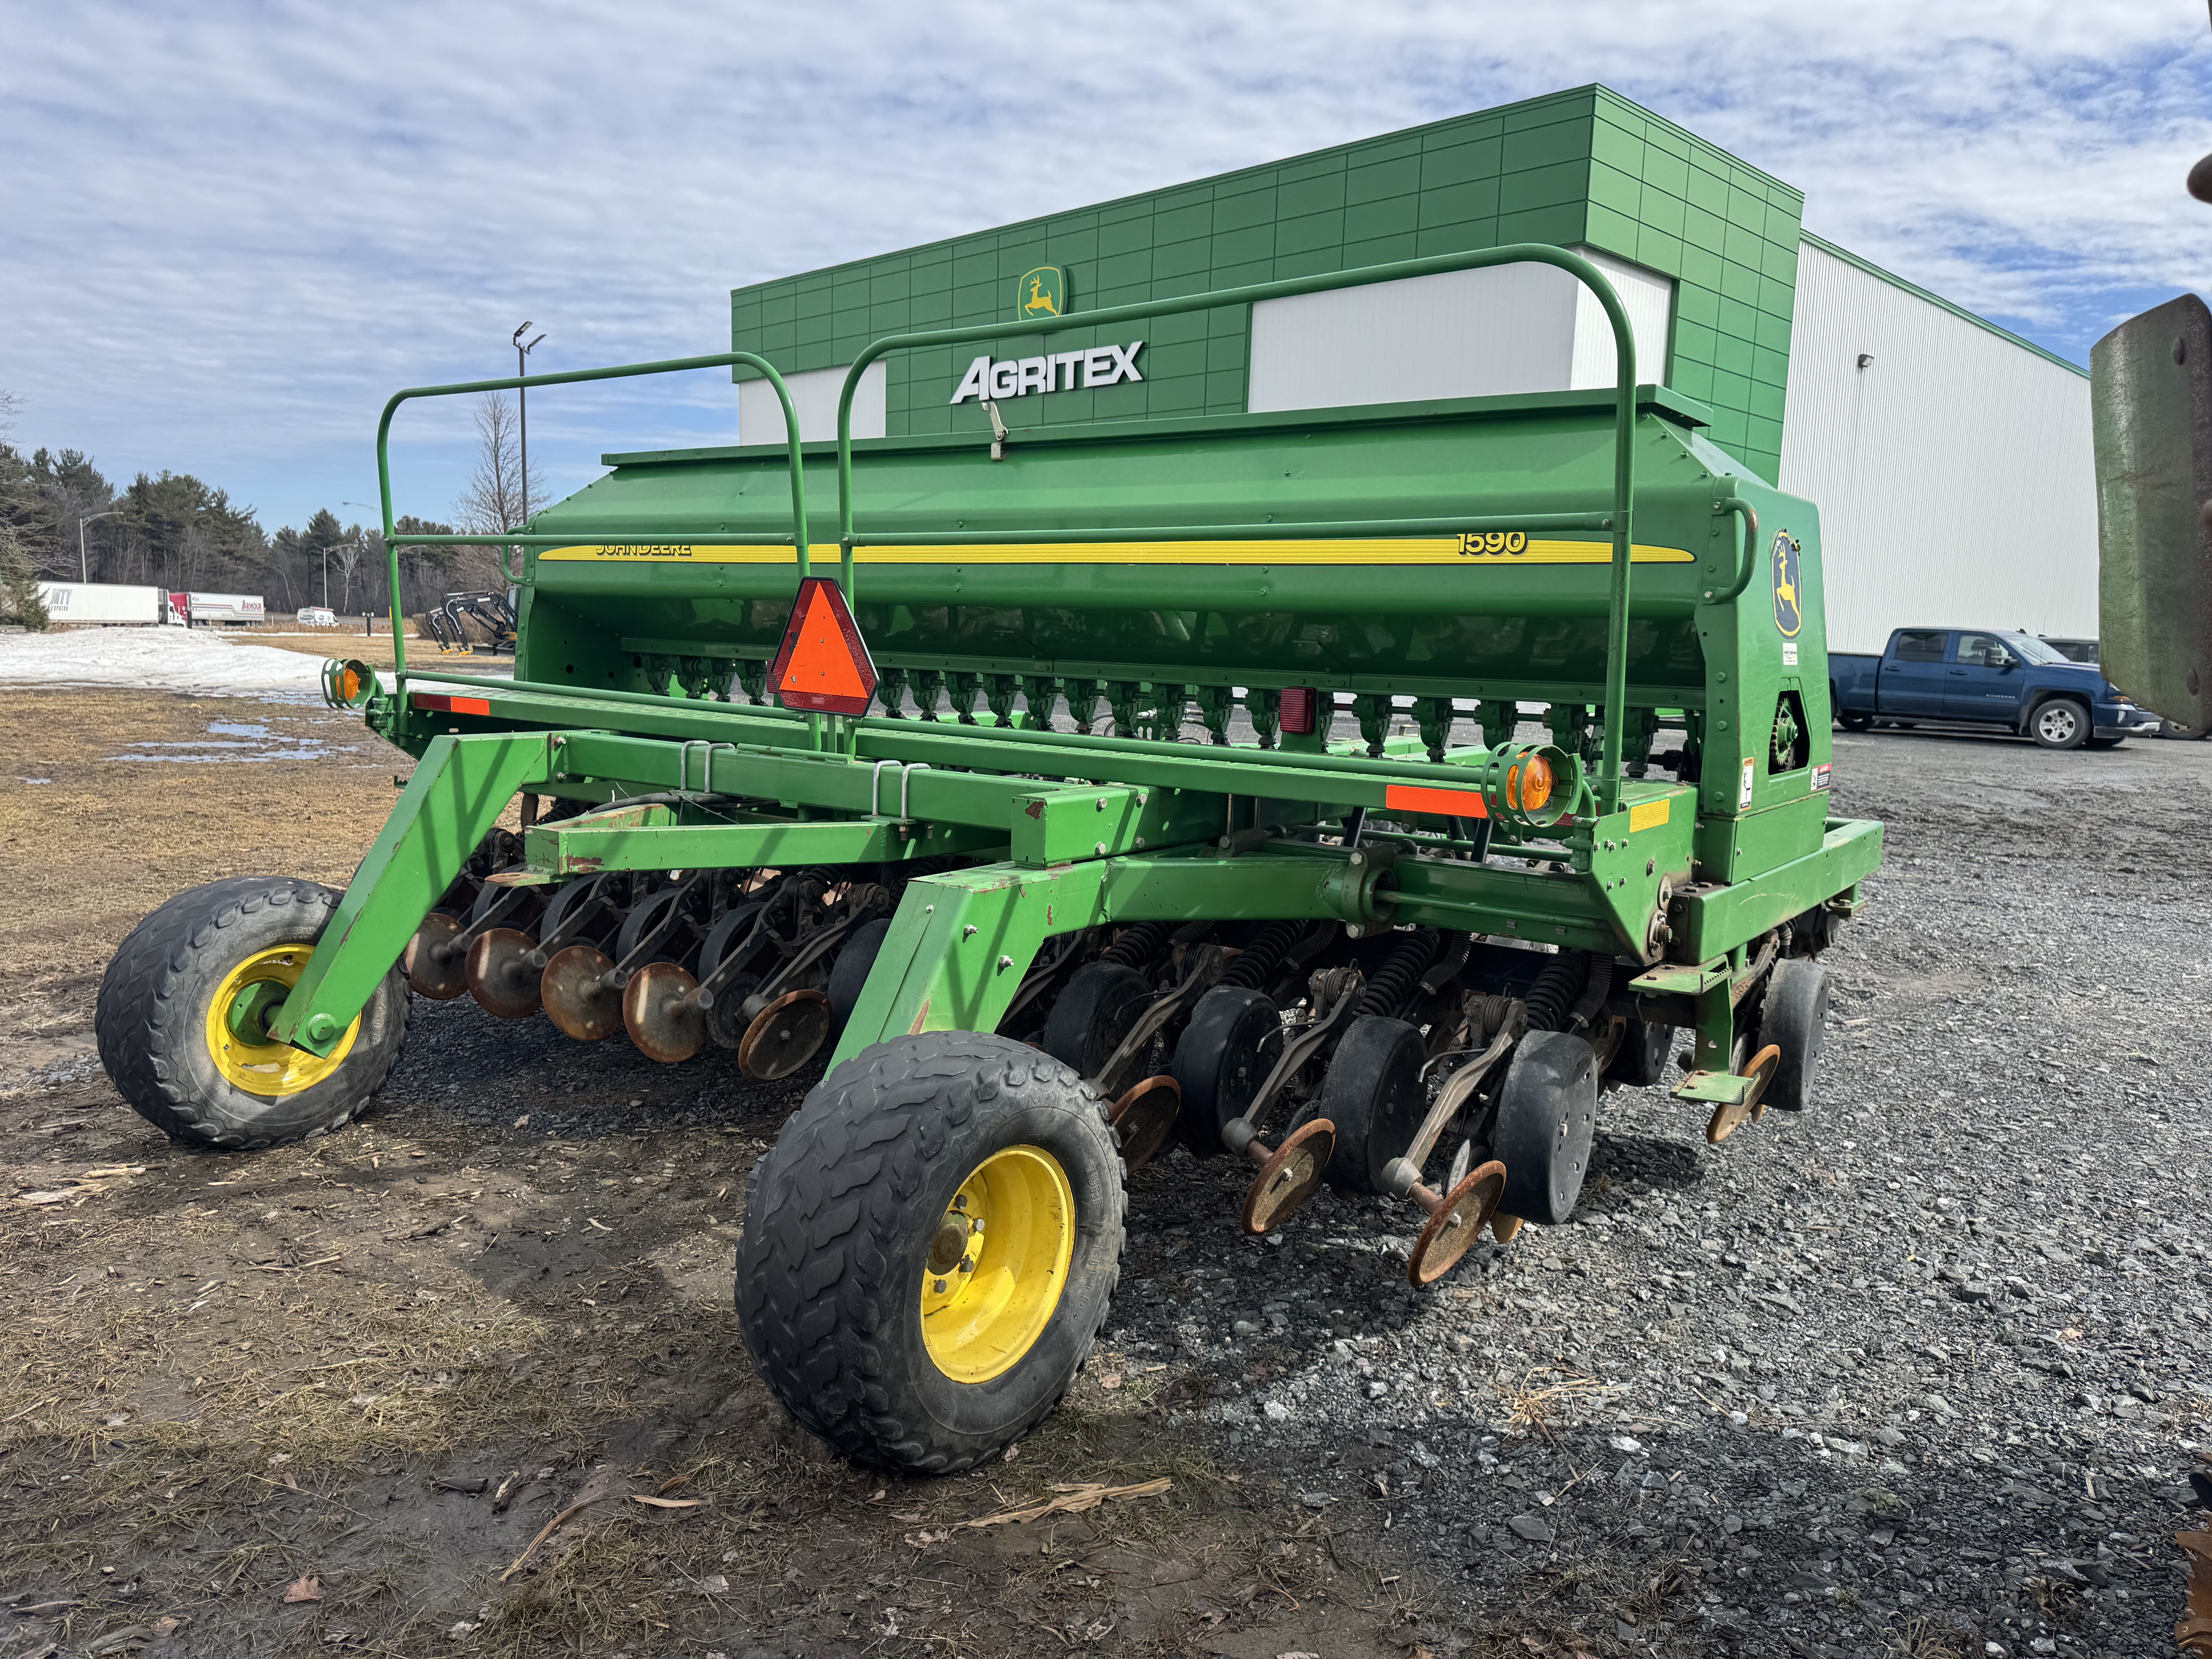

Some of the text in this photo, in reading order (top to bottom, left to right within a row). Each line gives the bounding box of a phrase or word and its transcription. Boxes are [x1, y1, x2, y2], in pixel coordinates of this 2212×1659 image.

[950, 340, 1143, 404] AGRITEX
[1457, 532, 1527, 555] 1590
[1085, 1161, 1104, 1209] TURF
[1093, 1221, 1103, 1233] &
